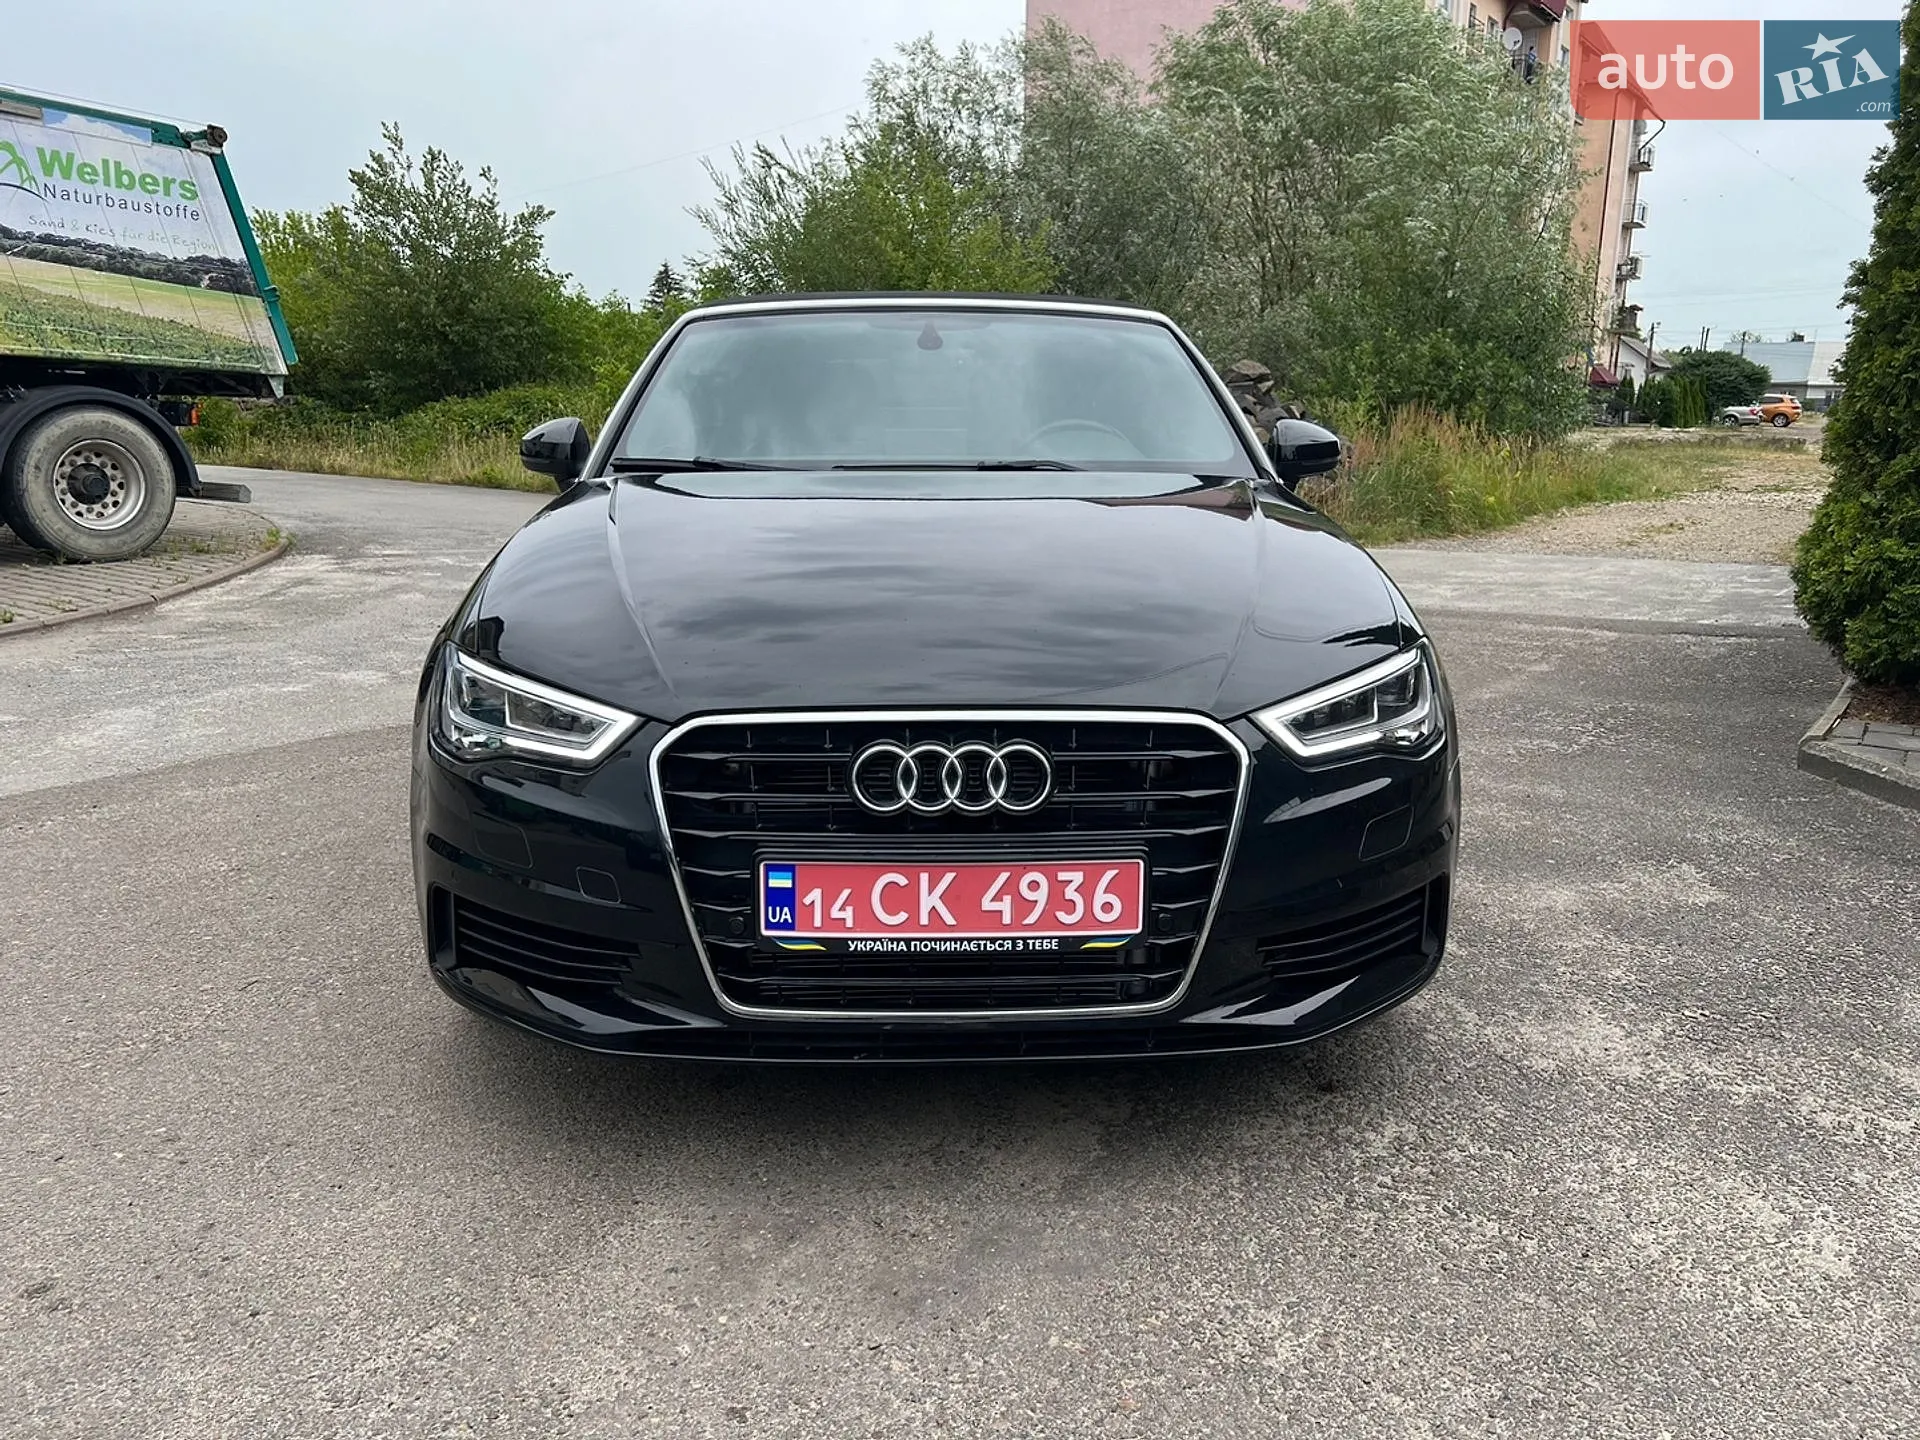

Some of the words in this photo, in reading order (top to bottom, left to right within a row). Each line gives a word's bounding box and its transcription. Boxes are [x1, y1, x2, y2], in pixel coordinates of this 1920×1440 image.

[36, 146, 200, 201] Welbers
[43, 183, 200, 222] Naturbaustoffe
[28, 214, 65, 230] Sand
[71, 220, 79, 231] &
[149, 231, 169, 244] die
[173, 234, 218, 255] Region
[768, 906, 792, 924] UA
[802, 887, 855, 928] 14
[870, 871, 958, 927] CK
[981, 868, 1124, 926] 4936
[848, 938, 908, 952] УКРАЇНА
[910, 940, 1012, 952] ПОЧИНАЄТЬСЯ
[1026, 938, 1059, 950] ТЕБЕ
